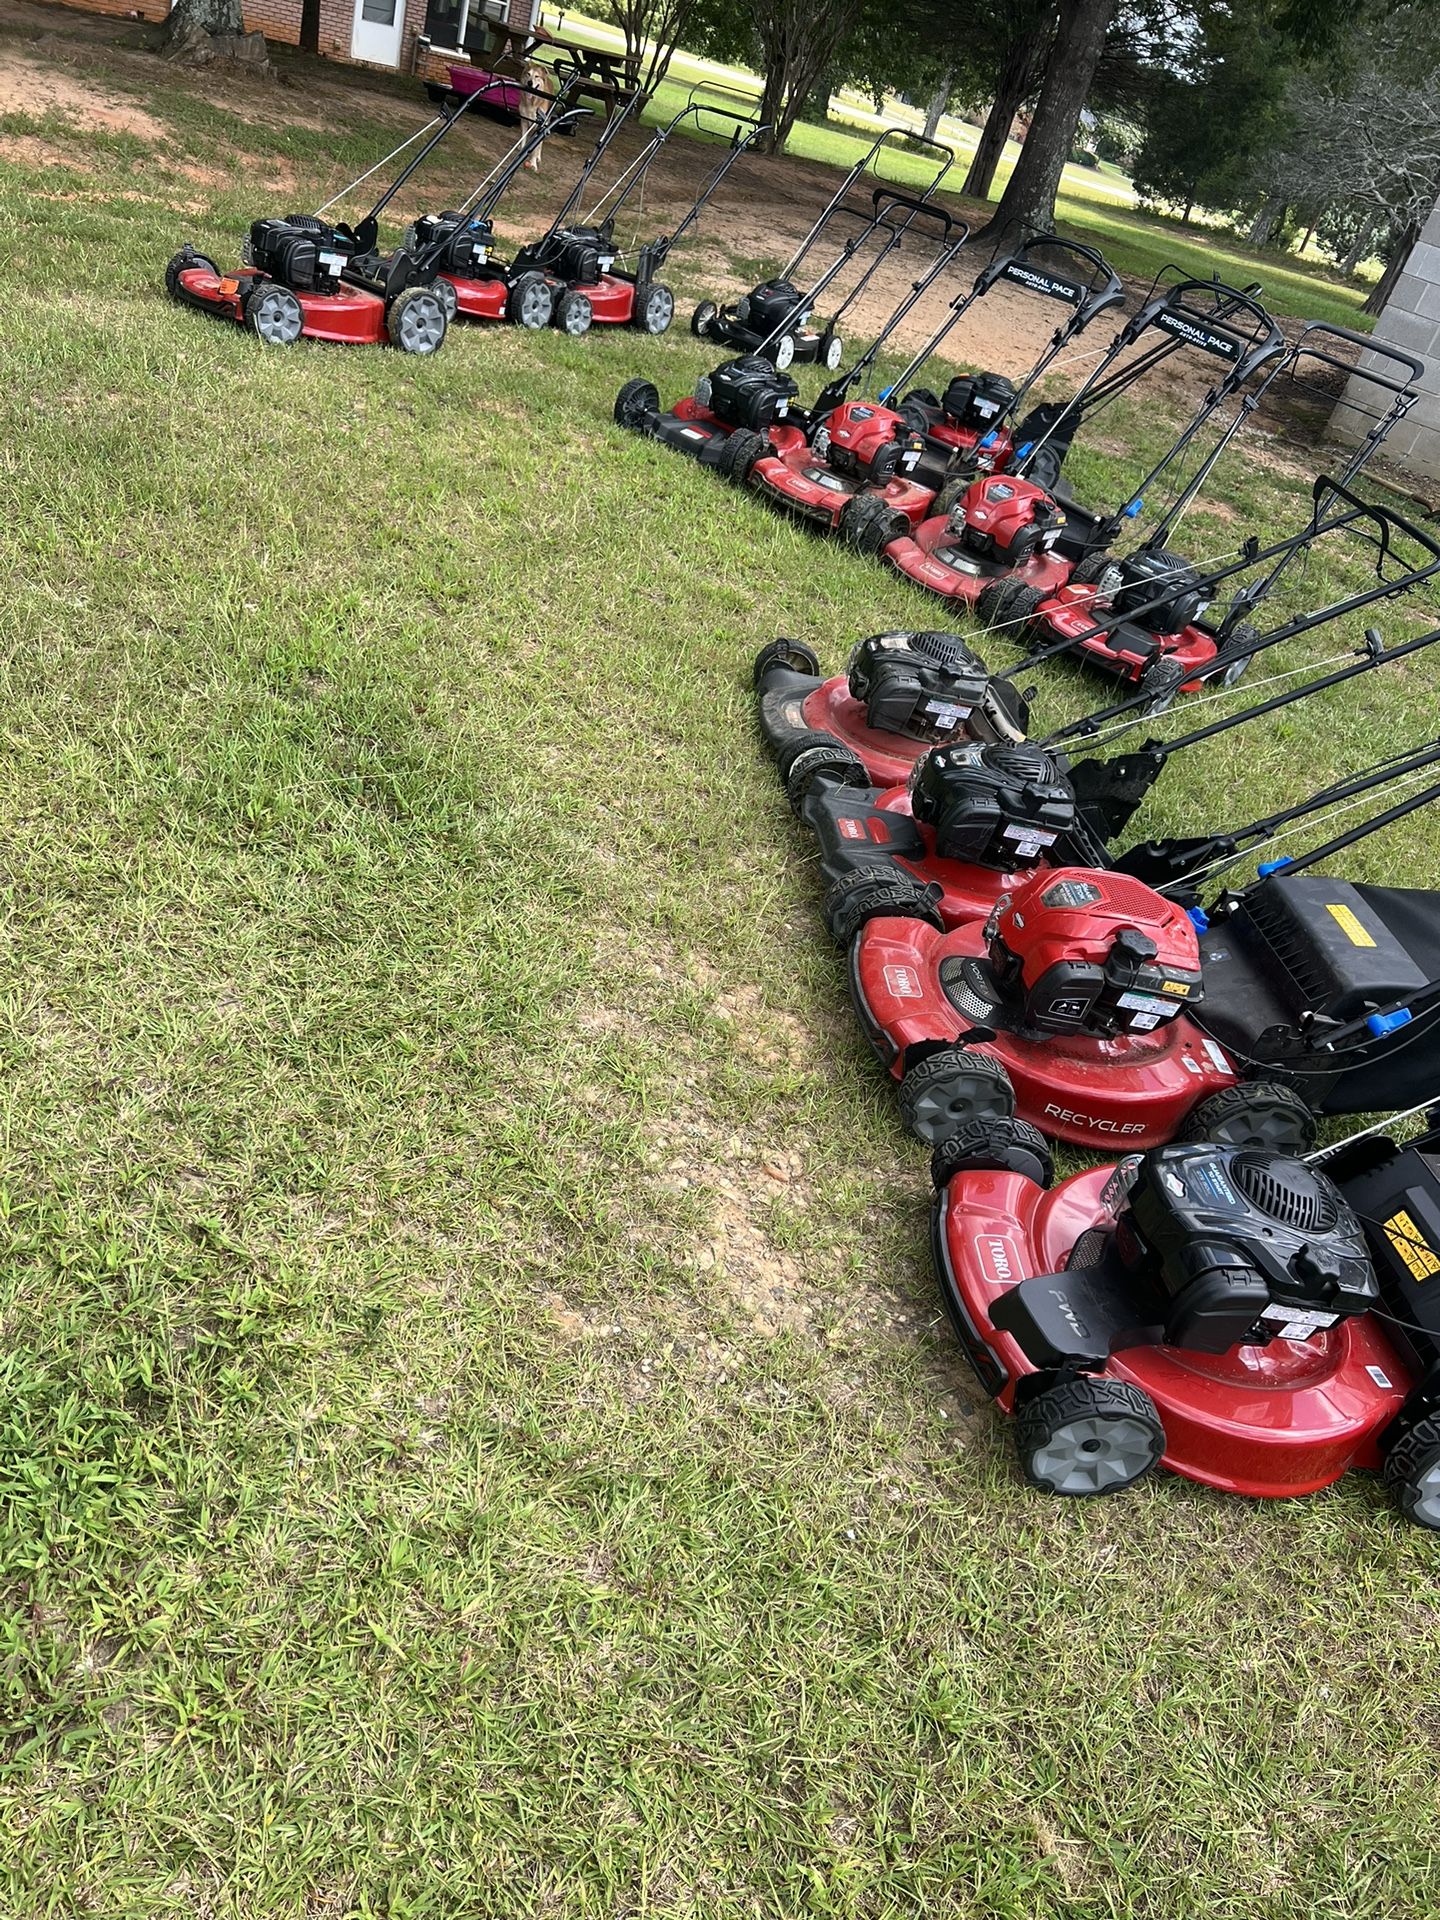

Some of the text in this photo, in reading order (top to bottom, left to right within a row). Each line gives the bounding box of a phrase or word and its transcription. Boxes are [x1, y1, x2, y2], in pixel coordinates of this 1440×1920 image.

[1007, 265, 1077, 298] PERSONAL PACE
[1160, 313, 1233, 353] PERSONAL PACE
[845, 819, 859, 838] TORO
[894, 968, 913, 994] TORO
[1044, 1103, 1146, 1134] RECYCLER
[1208, 1170, 1225, 1196] TO START
[1209, 1162, 1236, 1205] GUARANTEED
[988, 1239, 1012, 1280] TORO
[1048, 1289, 1091, 1339] FWD
